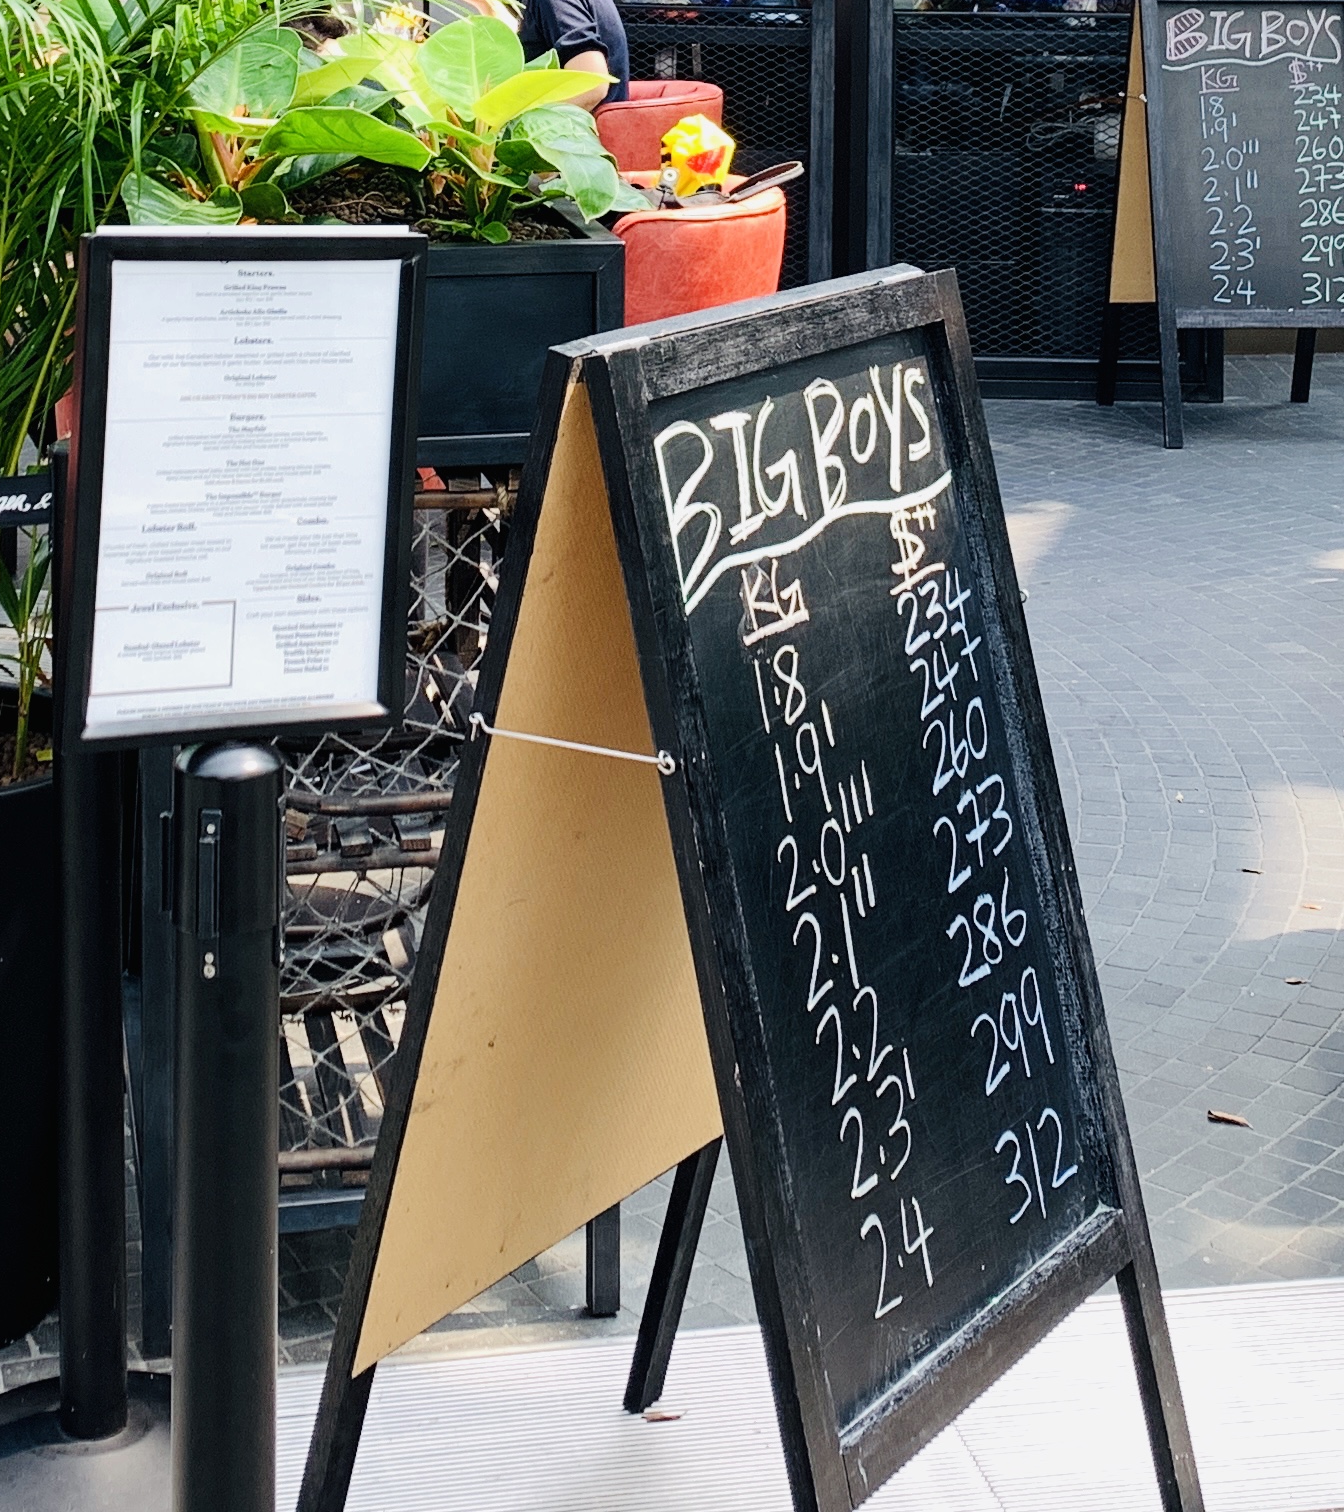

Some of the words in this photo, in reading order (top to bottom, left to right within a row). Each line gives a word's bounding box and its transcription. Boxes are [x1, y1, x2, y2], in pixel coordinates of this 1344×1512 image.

[1166, 8, 1252, 61] BIG
[1258, 8, 1342, 64] BOYS
[1201, 66, 1238, 90] KG
[1200, 96, 1225, 120] 1.8
[1293, 83, 1343, 107] 234
[1293, 106, 1342, 133] 247
[1294, 135, 1344, 163] 260
[1206, 204, 1257, 235] 2.2
[1212, 274, 1256, 306] 2.4
[653, 395, 808, 605] BIG
[803, 364, 932, 517] BOYS
[739, 558, 809, 632] KG
[754, 643, 807, 734] 1.8
[896, 567, 972, 655] 234
[908, 622, 983, 721] 247
[921, 696, 988, 796] 260
[932, 773, 1013, 894] 273
[815, 985, 894, 1106] 2.2
[945, 866, 1027, 988] 286
[970, 965, 1055, 1097] 299
[860, 1196, 935, 1320] 2.4
[994, 1107, 1079, 1225] 312
